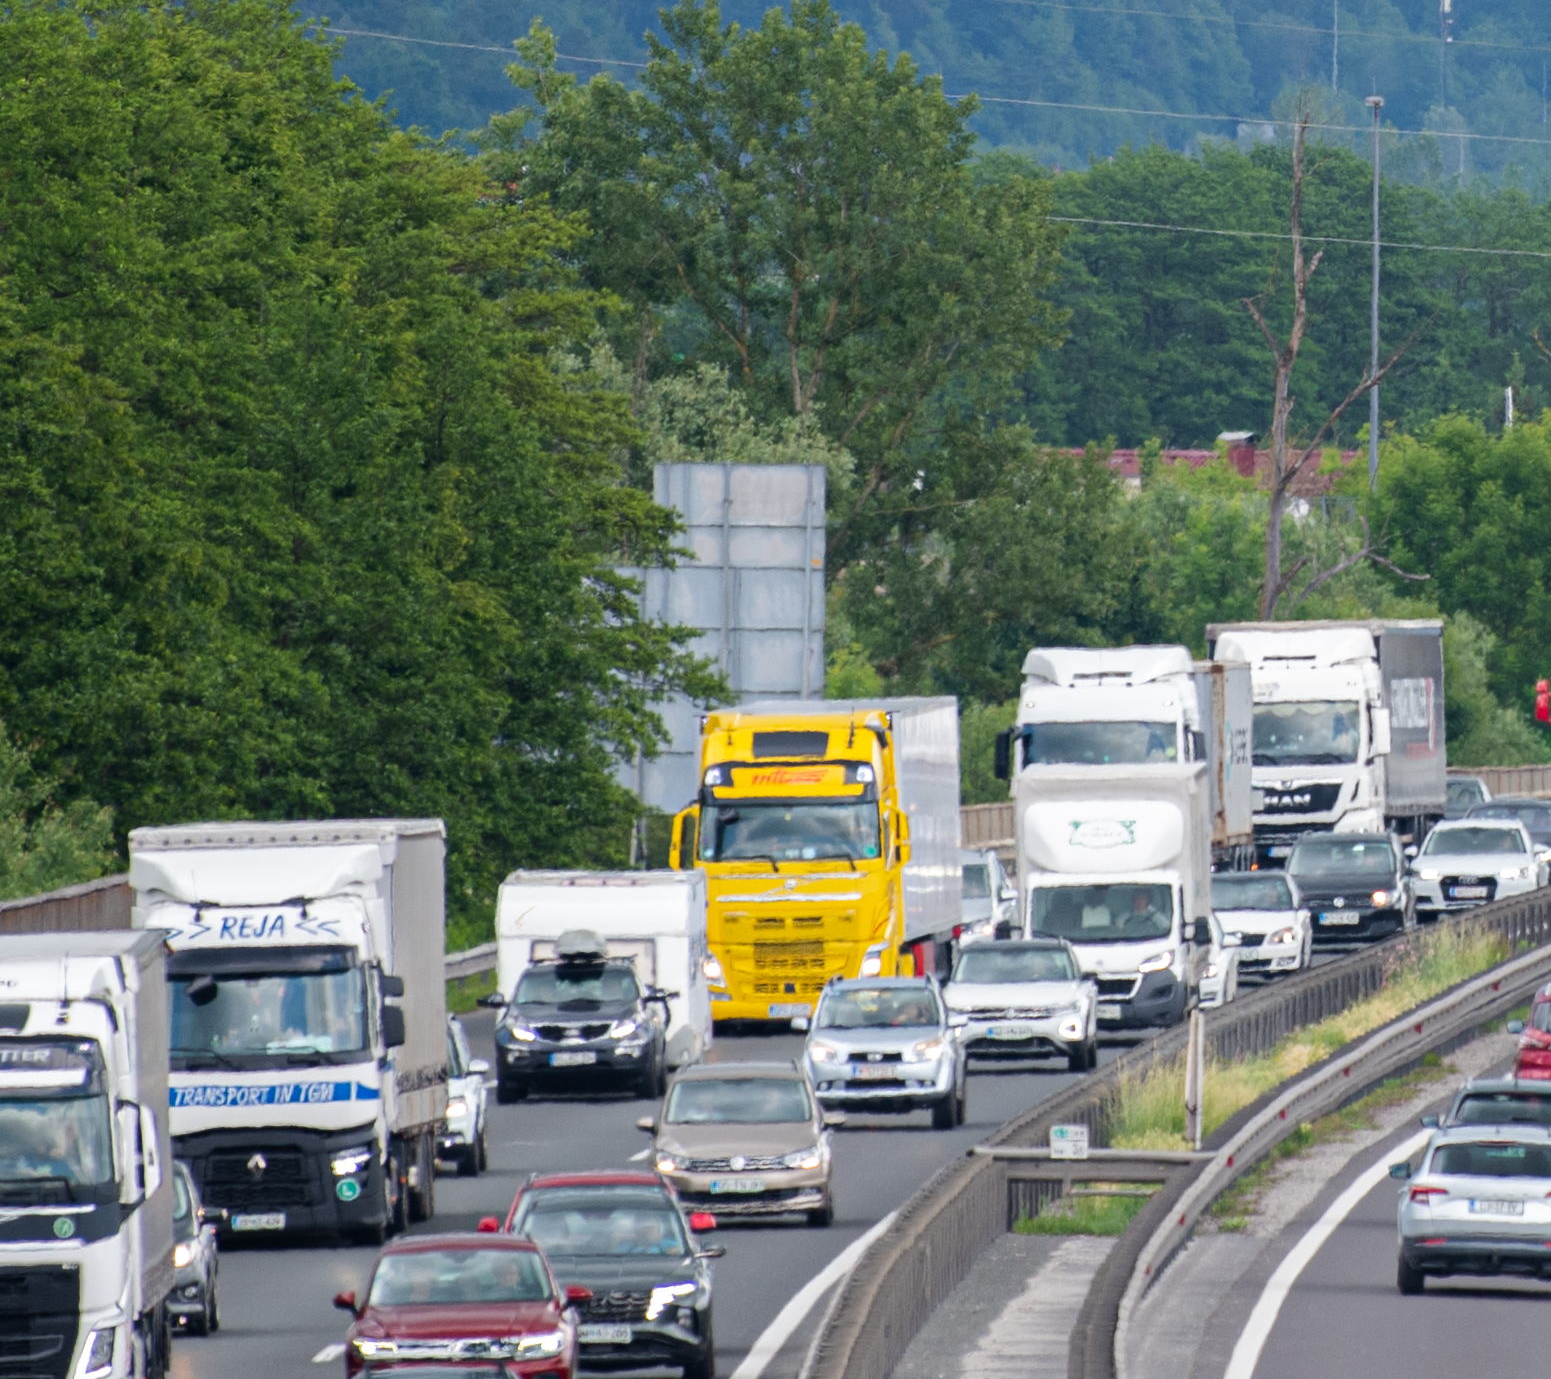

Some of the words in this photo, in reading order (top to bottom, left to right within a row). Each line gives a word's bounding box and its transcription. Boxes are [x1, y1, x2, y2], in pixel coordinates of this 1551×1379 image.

[219, 914, 285, 940] REJA
[174, 1086, 270, 1107] TRANSPORT
[274, 1085, 293, 1104] IN
